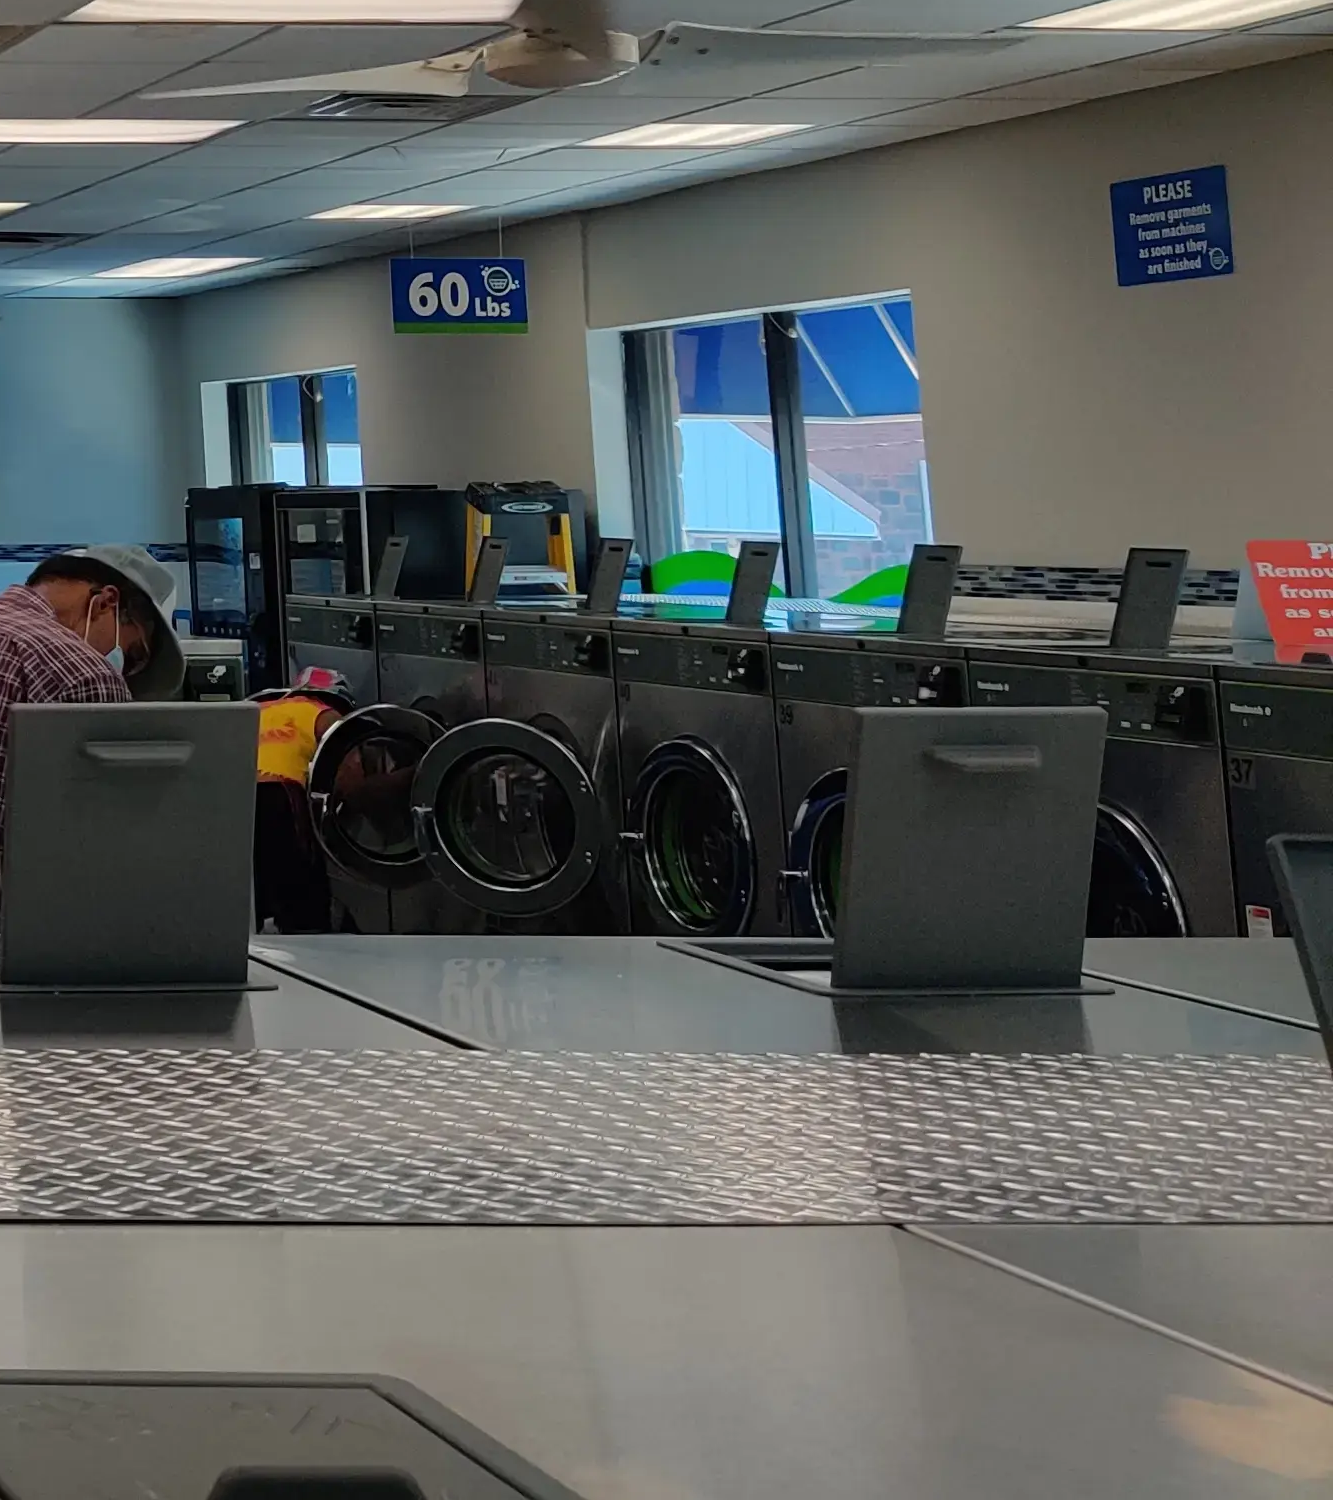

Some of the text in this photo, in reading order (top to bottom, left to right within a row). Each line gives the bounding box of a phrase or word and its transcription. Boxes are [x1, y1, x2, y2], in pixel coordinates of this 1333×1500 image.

[1143, 180, 1193, 204] PLEASE
[1129, 202, 1212, 226] Remove garments
[1138, 222, 1206, 242] from machines
[1139, 239, 1208, 259] as soon as they
[1147, 255, 1202, 274] are finished
[408, 271, 511, 318] 60 Lbs
[1279, 583, 1333, 598] from
[1284, 608, 1312, 619] as
[1230, 758, 1253, 784] 37
